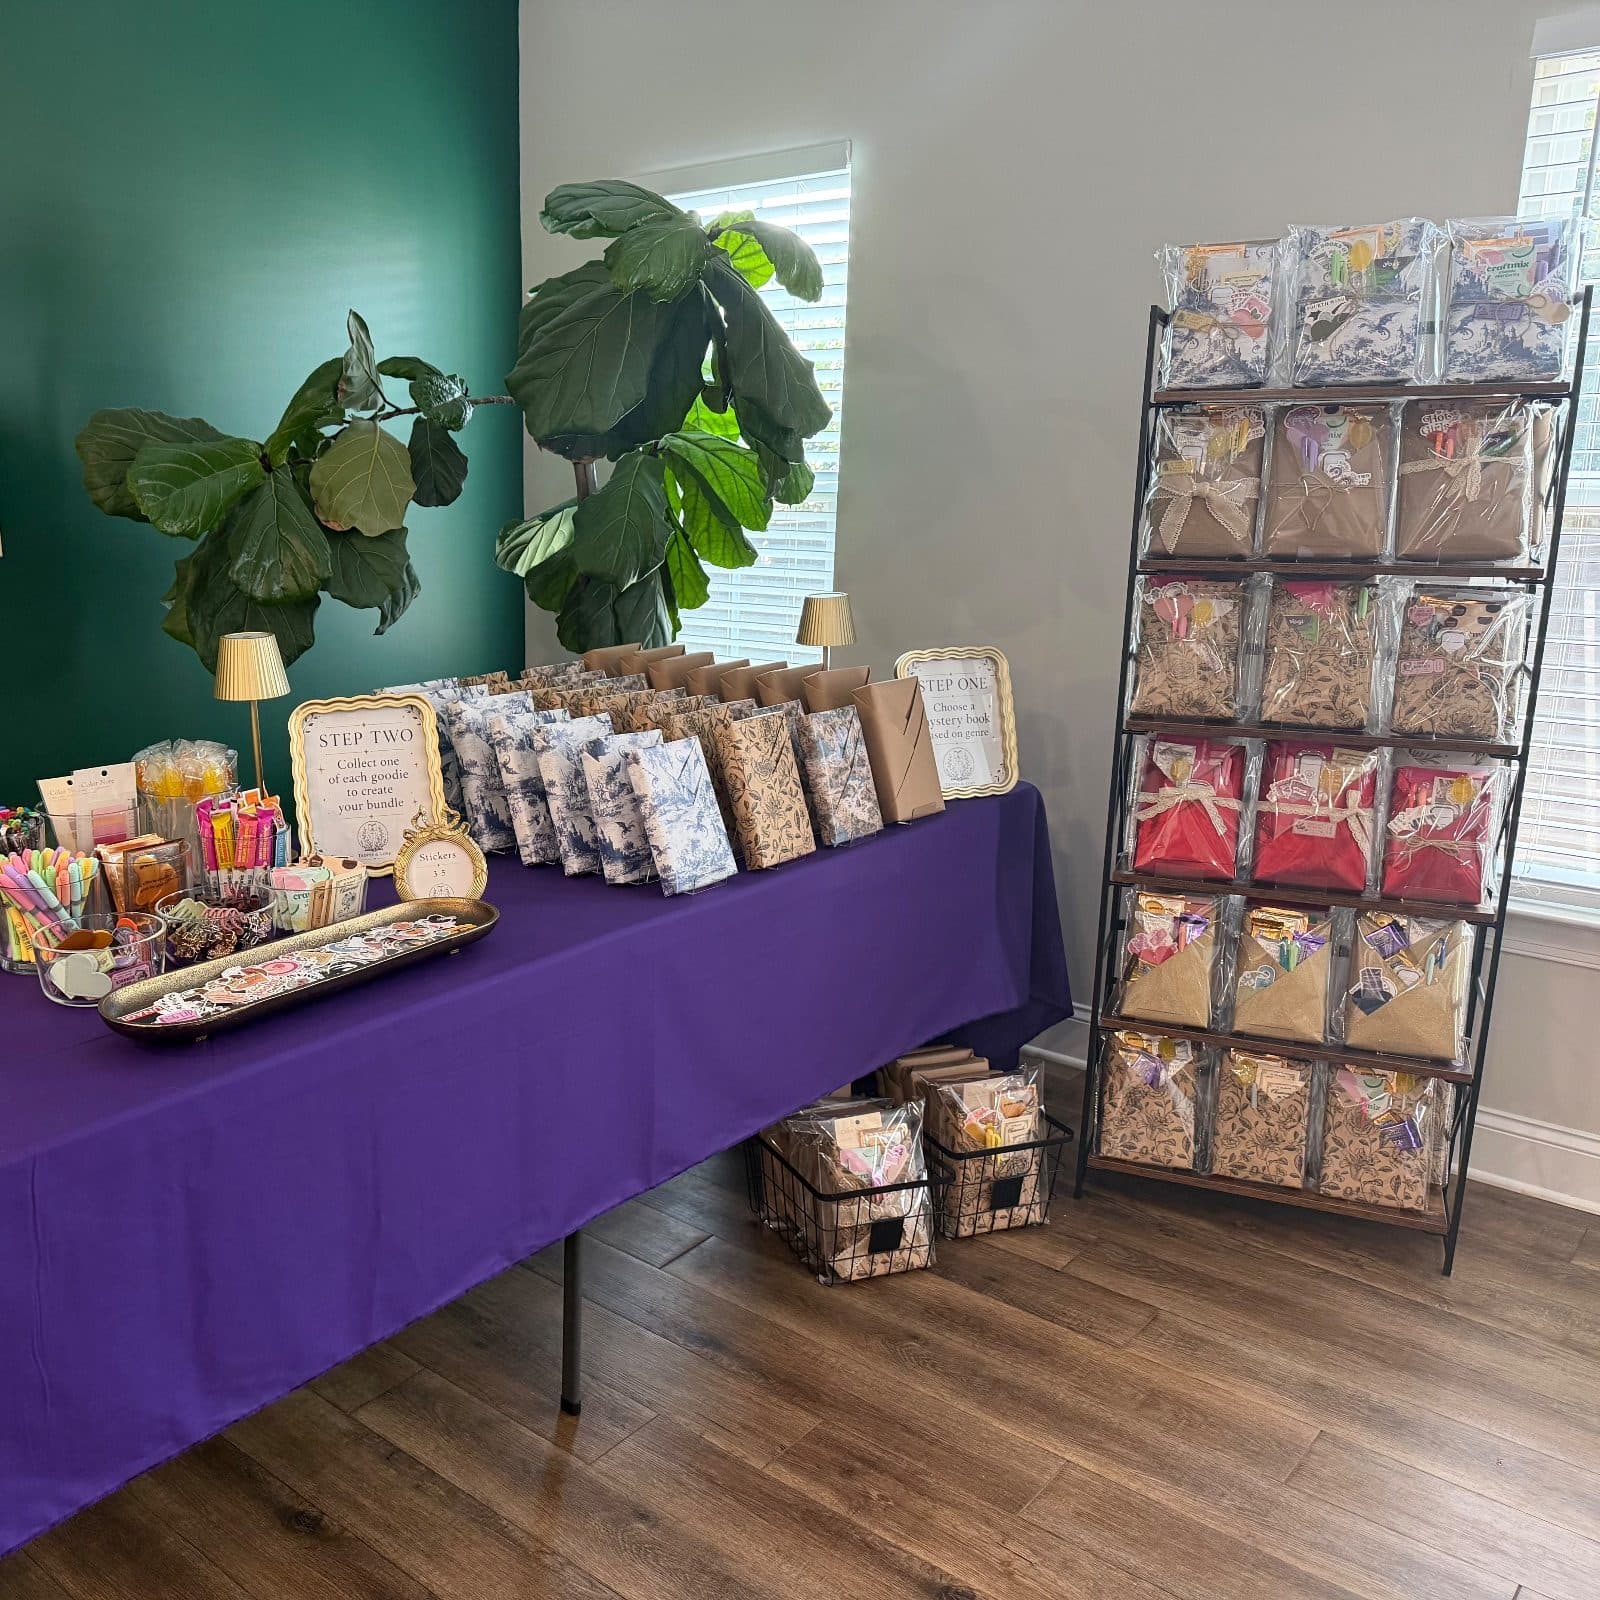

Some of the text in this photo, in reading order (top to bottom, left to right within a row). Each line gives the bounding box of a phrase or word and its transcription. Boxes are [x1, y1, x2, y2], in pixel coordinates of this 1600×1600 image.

[919, 676, 988, 692] STEP ONE
[933, 702, 975, 713] Choose a
[929, 712, 990, 730] ystery book
[319, 728, 414, 749] STEP TWO
[931, 729, 950, 739] sed
[965, 729, 990, 740] genre
[337, 758, 400, 770] Collect one
[328, 769, 409, 785] of each goodie
[346, 786, 393, 797] to create
[338, 798, 405, 816] your bundle
[419, 851, 457, 861] Stickers
